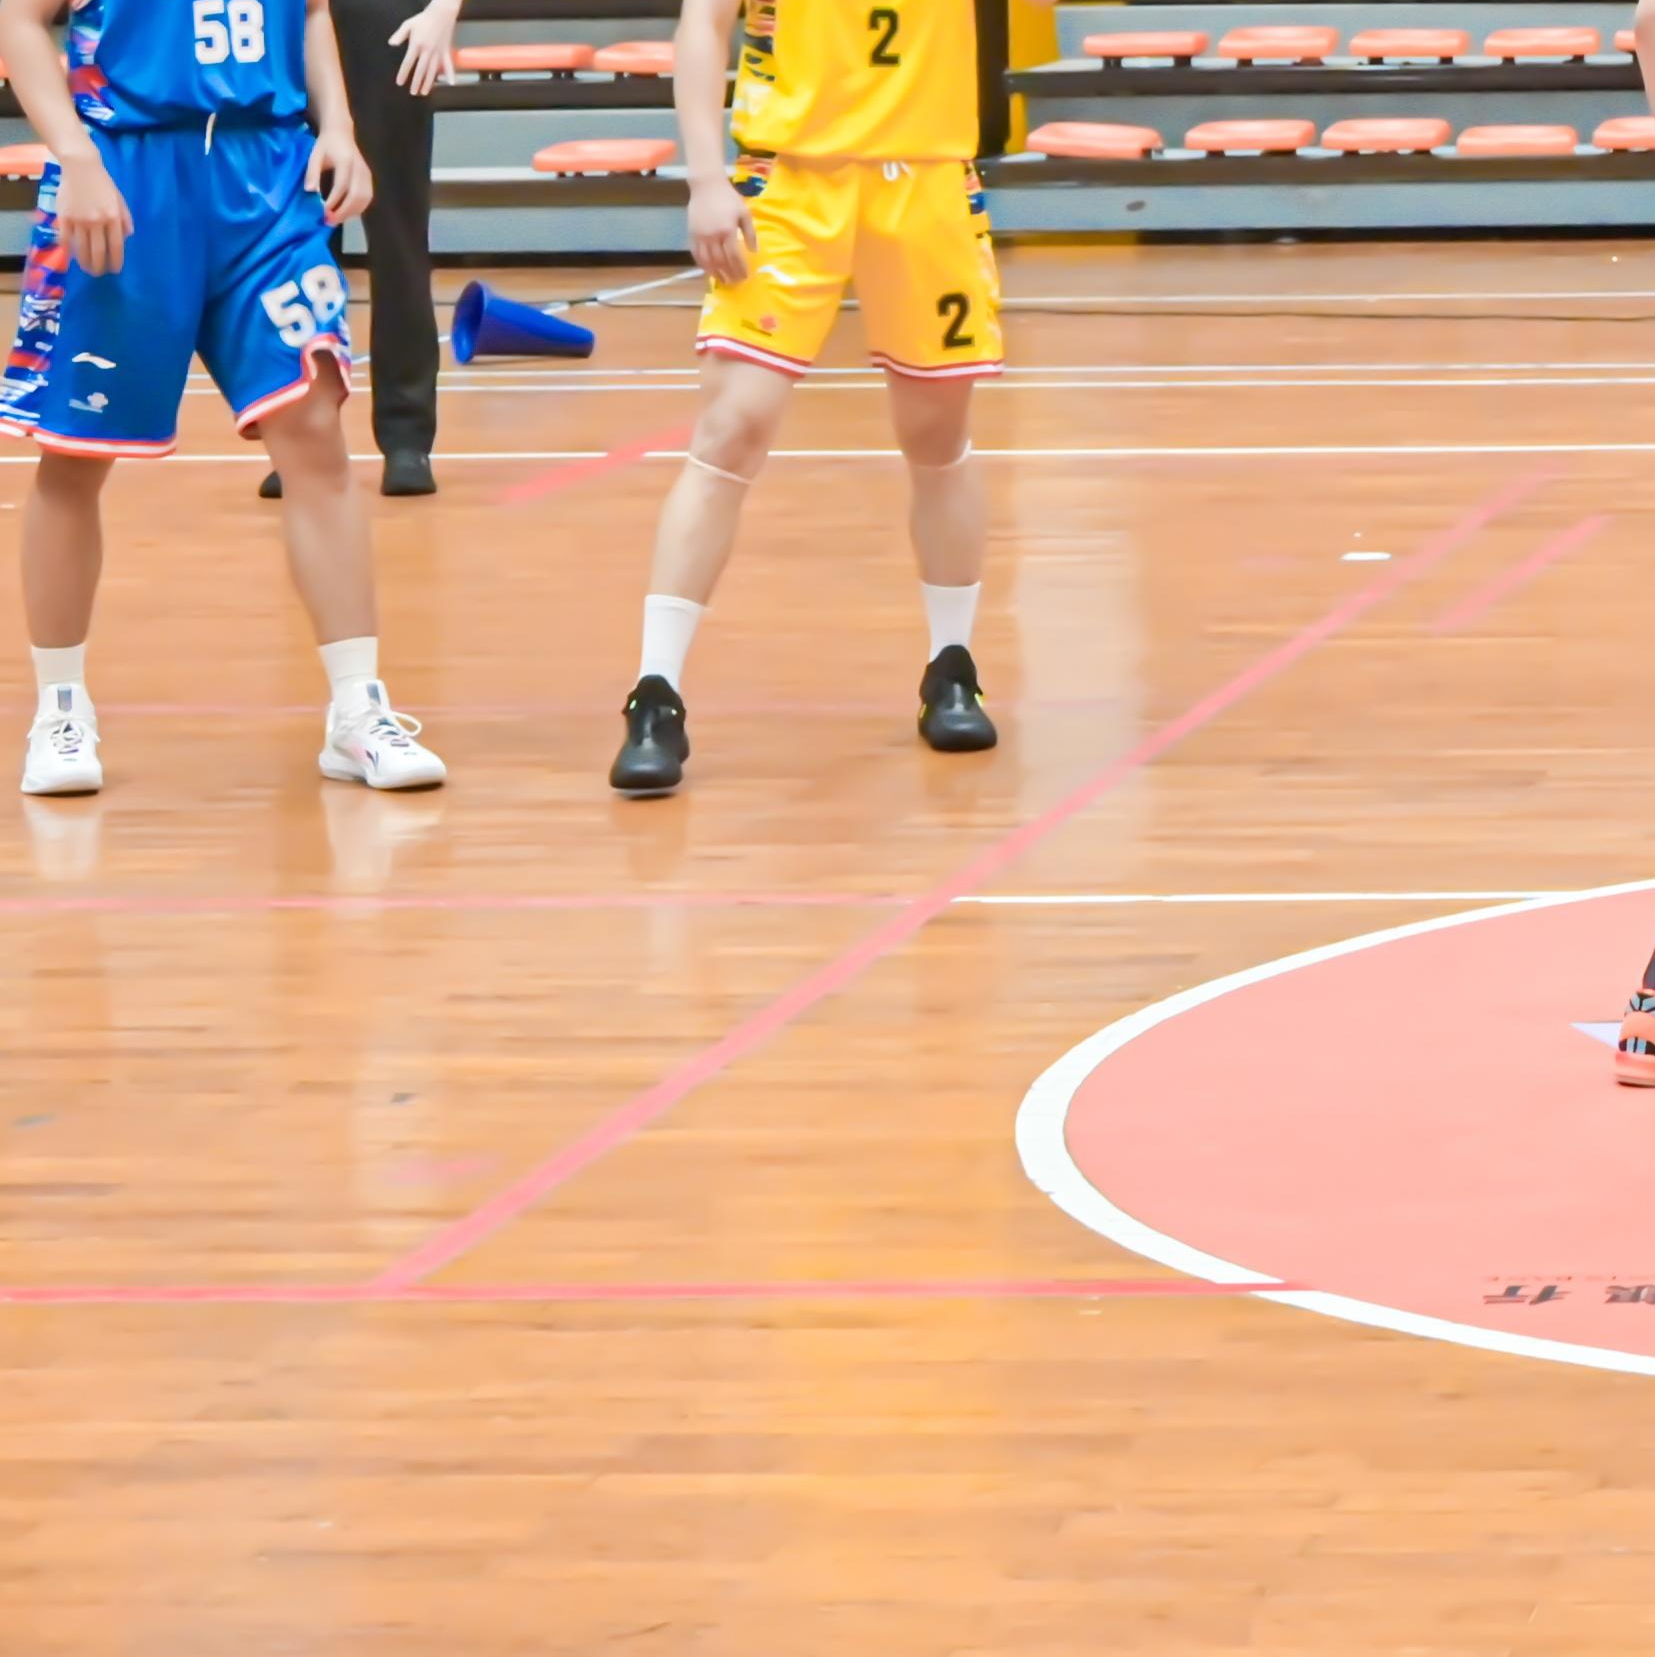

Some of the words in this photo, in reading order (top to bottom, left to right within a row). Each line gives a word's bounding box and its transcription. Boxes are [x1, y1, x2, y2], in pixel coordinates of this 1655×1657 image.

[868, 7, 901, 67] 2
[260, 264, 346, 348] 58
[937, 292, 975, 350] 2
